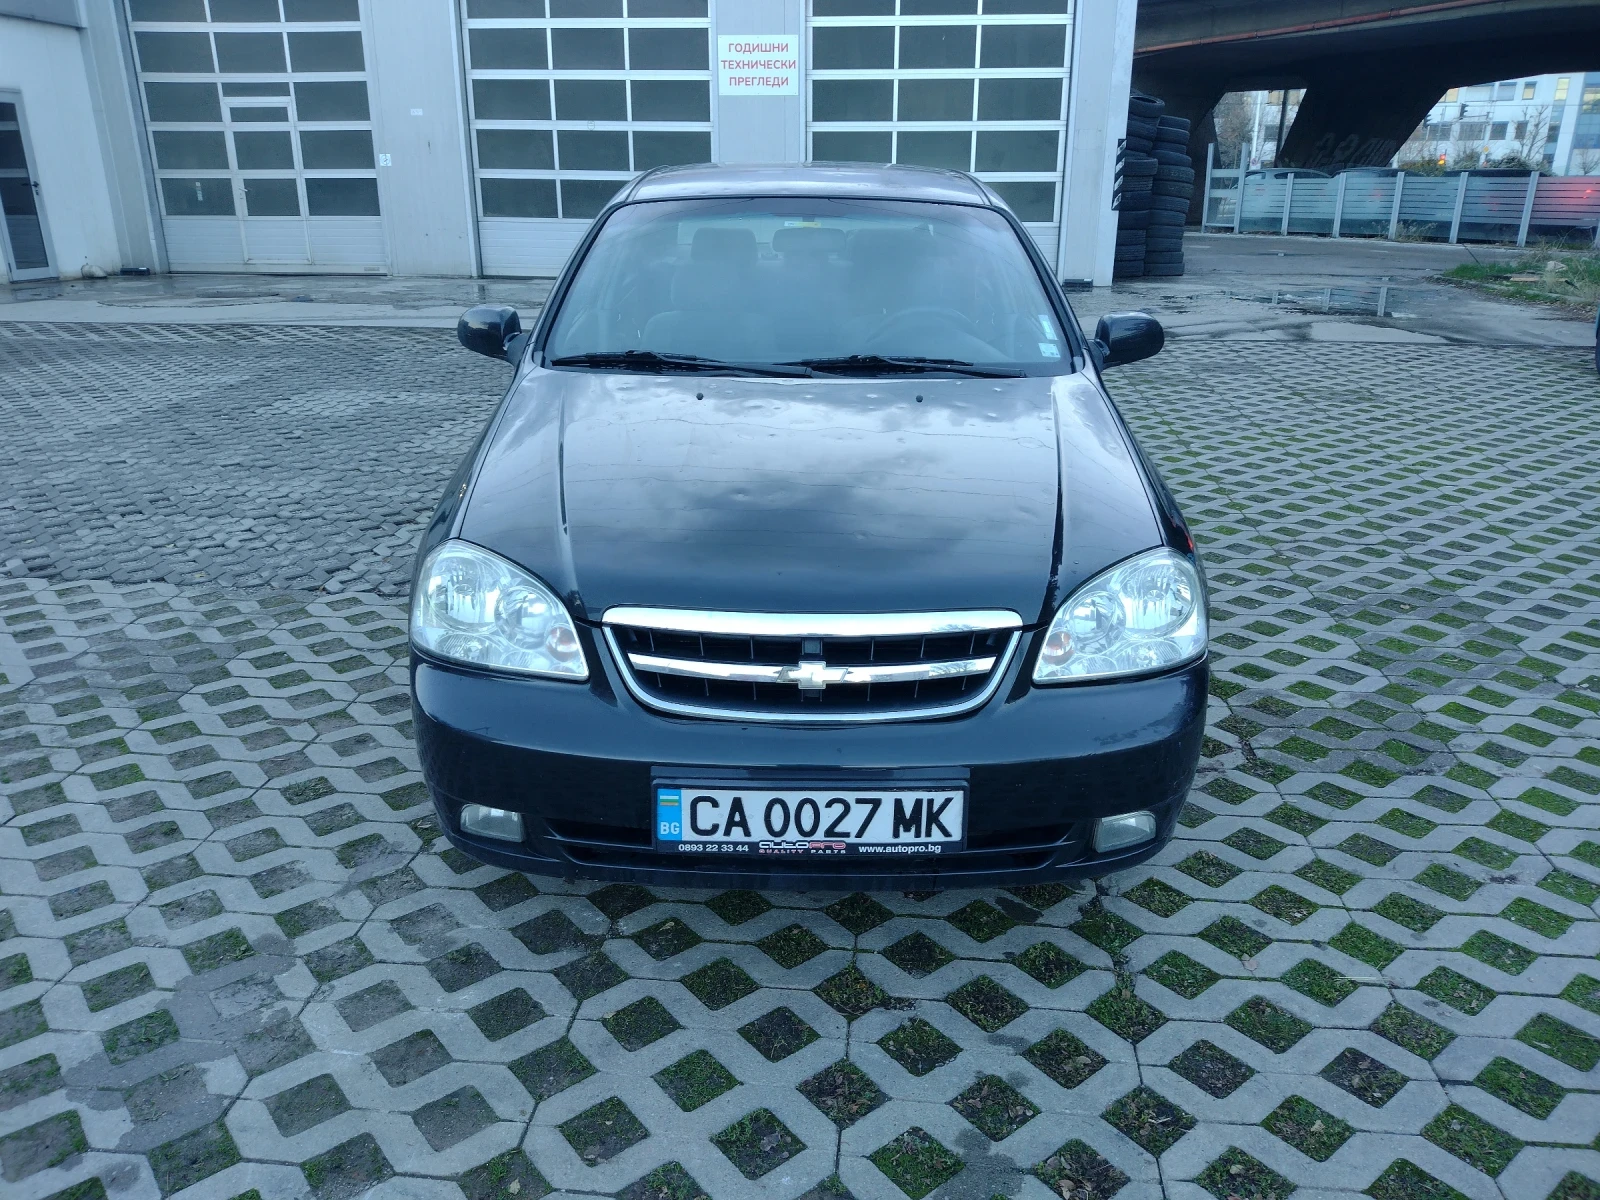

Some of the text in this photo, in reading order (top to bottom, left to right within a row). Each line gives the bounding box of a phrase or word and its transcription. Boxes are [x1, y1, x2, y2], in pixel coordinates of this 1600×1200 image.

[728, 43, 789, 54] ГОДИШНИ
[720, 60, 796, 70] ТЕХНИЧЕСКИ
[729, 77, 789, 88] ПРЕГЛЕДИ
[689, 795, 955, 839] CA 0027 MK
[660, 821, 680, 835] BG
[678, 843, 703, 852] 0893
[705, 844, 719, 852] 22
[720, 844, 734, 852] 33
[858, 843, 942, 854] www.autopro.bg
